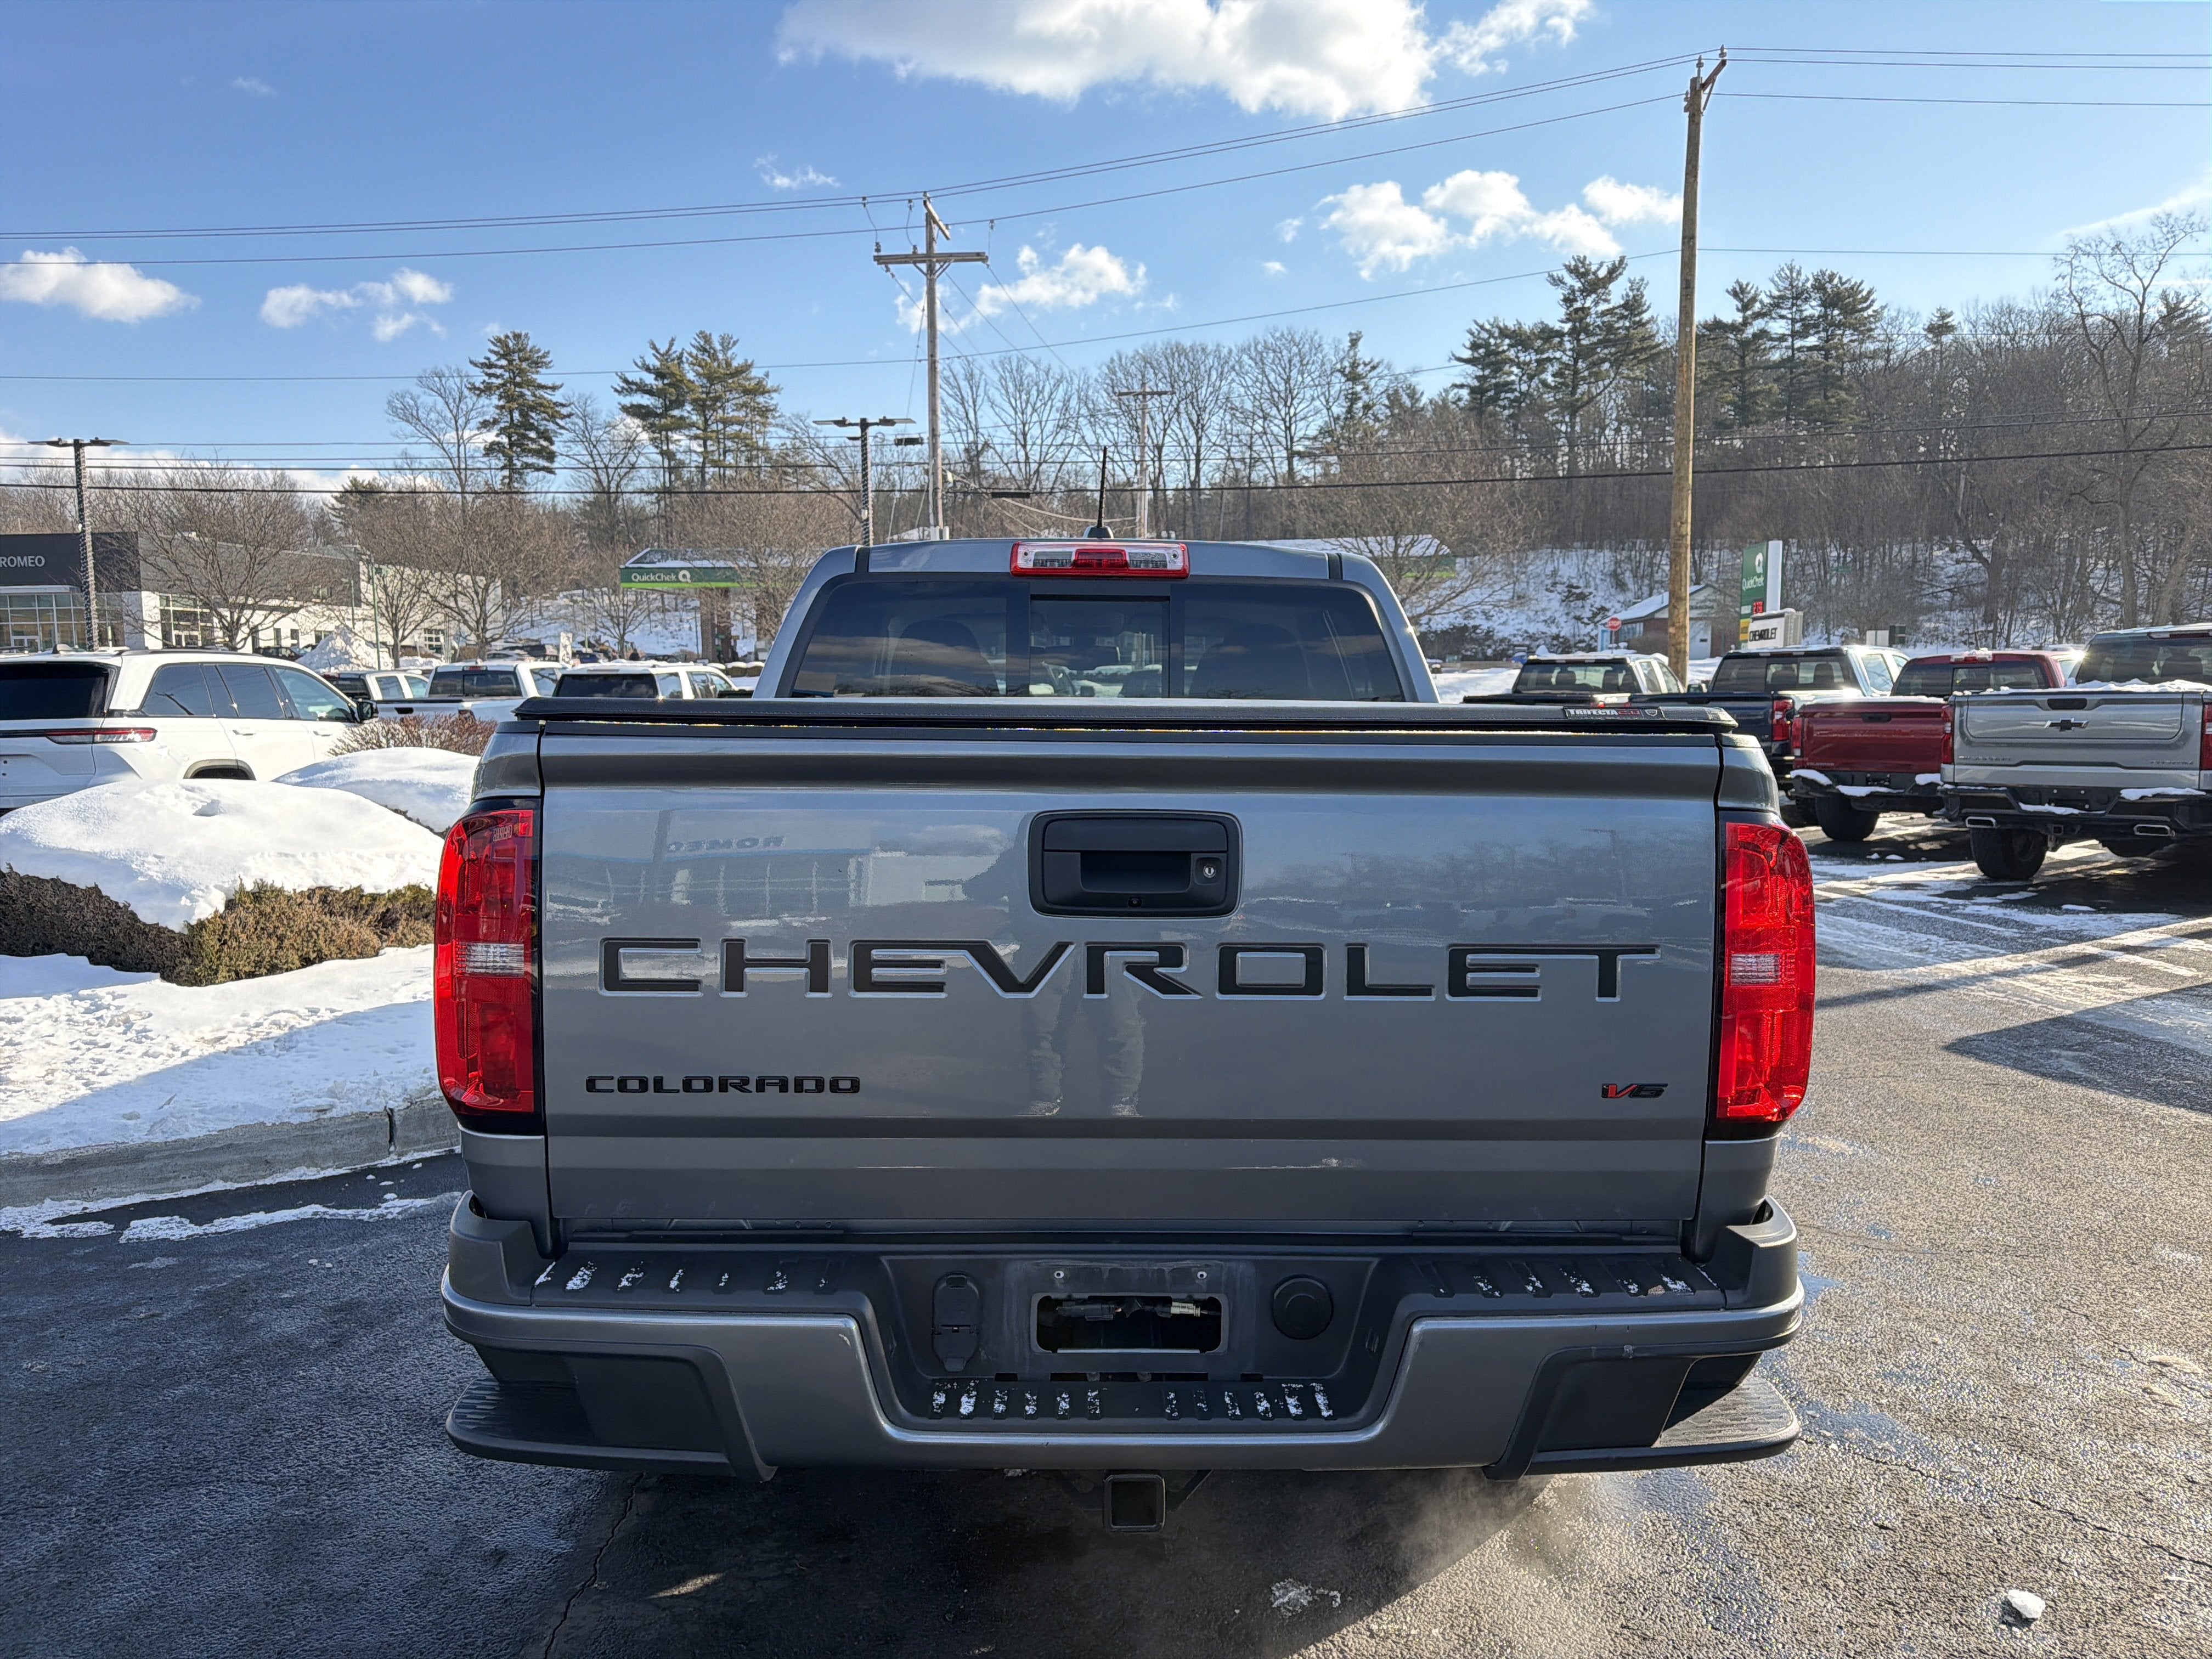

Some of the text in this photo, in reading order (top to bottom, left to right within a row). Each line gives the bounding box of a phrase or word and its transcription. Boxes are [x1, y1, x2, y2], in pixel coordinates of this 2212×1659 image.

[0, 556, 45, 567] ROMEO
[632, 573, 676, 582] QuickChek
[1742, 575, 1764, 591] QuickChek
[1749, 627, 1778, 642] CHEVROLET
[598, 937, 1660, 1002] CHEVROLET
[586, 1076, 860, 1093] COLORADO
[1601, 1084, 1668, 1098] V6
